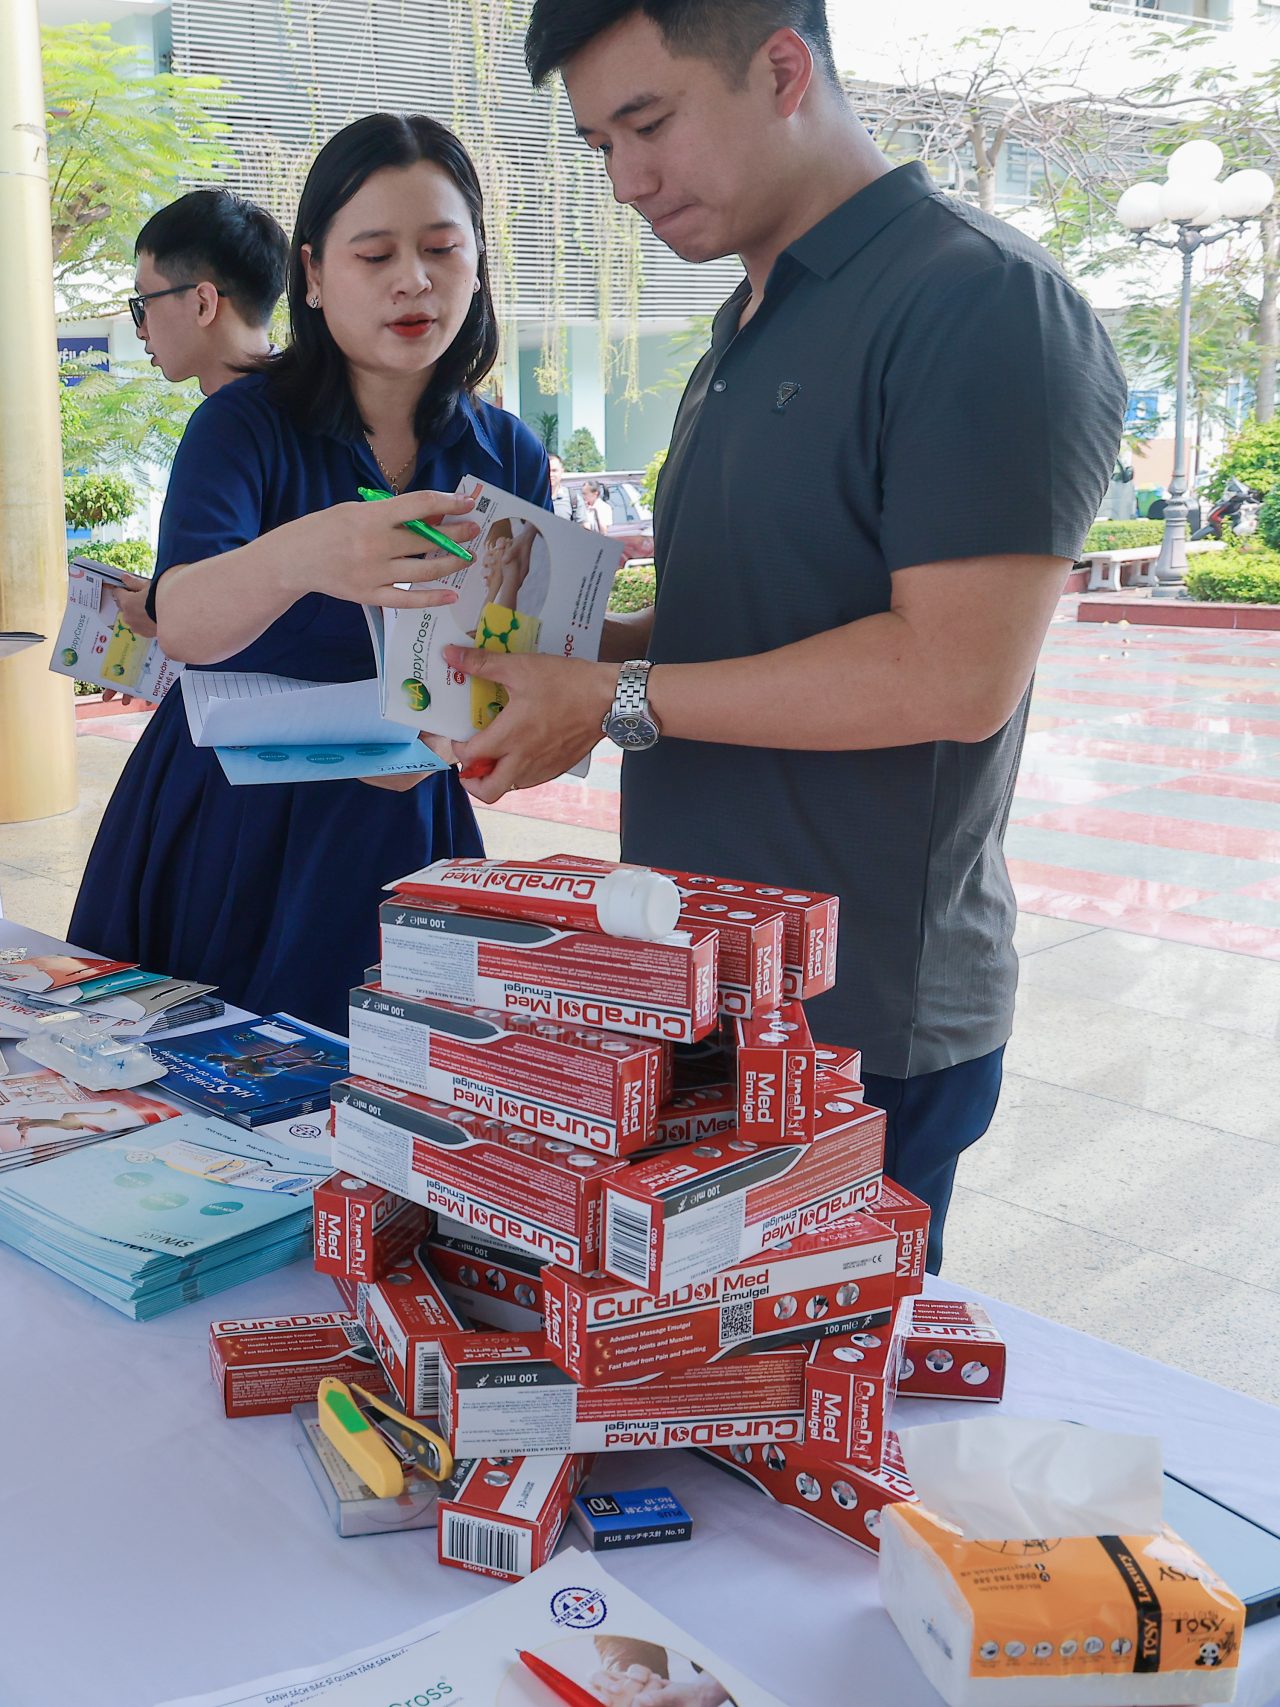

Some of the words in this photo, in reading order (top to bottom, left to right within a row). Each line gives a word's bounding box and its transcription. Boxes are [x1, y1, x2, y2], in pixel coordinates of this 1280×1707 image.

[440, 869, 481, 890] Med
[486, 869, 596, 901] CuraDol
[429, 918, 446, 930] 100
[807, 928, 816, 980] Emulgel
[814, 927, 825, 977] Med
[756, 947, 764, 1000] Emulgel
[763, 945, 772, 996] Med
[503, 982, 553, 999] Emulgel
[695, 967, 703, 1021] Emulgel
[702, 964, 710, 1017] Med
[390, 1005, 405, 1017] 100
[505, 993, 551, 1017] Med
[557, 998, 687, 1040] CuraDol
[452, 1076, 495, 1096] Emulgel
[744, 1070, 756, 1124] Emulgel
[758, 1072, 775, 1124] Med
[368, 1104, 382, 1115] 100
[453, 1087, 493, 1113] Med
[621, 1082, 631, 1137] Emulgel
[629, 1080, 643, 1133] Med
[504, 1100, 611, 1150] CuraDol
[426, 1179, 466, 1203] Emulgel
[706, 1185, 722, 1198] 100
[427, 1190, 465, 1218] Med
[798, 1180, 881, 1235] CuraDol
[585, 1199, 594, 1254] Emulgel
[761, 1209, 798, 1231] Emulgel
[318, 1210, 328, 1259] Emulgel
[328, 1214, 342, 1261] Med
[470, 1204, 576, 1267] CuraDol
[761, 1221, 796, 1248] Med
[474, 1246, 488, 1257] 100
[896, 1230, 914, 1278] Med
[910, 1227, 924, 1278] Emulgel
[593, 1279, 720, 1322] CuraDol
[723, 1268, 770, 1294] Med
[721, 1284, 770, 1303] Emulgel
[218, 1313, 336, 1333] CuraDol
[543, 1289, 552, 1343] Emulgel
[550, 1296, 563, 1350] Med
[824, 1322, 840, 1335] 100
[609, 1332, 639, 1344] Advanced
[639, 1326, 667, 1338] Massage
[667, 1321, 691, 1332] Emulgel
[615, 1345, 638, 1356] Healthy
[638, 1342, 656, 1352] Joints
[656, 1338, 669, 1347] and
[669, 1334, 694, 1345] Muscles
[608, 1363, 622, 1372] Fast
[622, 1358, 640, 1369] Relief
[640, 1355, 655, 1364] from
[655, 1353, 669, 1362] Pain
[669, 1350, 681, 1358] and
[681, 1345, 707, 1356] Swelling
[519, 1373, 539, 1383] 100
[604, 1421, 660, 1433] Emulgel
[809, 1388, 824, 1441] Emulgel
[822, 1392, 843, 1443] Med
[605, 1431, 657, 1448] Med
[663, 1419, 799, 1446] CuraDol
[590, 1497, 613, 1512] 10
[643, 1495, 675, 1506] No.10
[656, 1510, 683, 1519] PLUS
[604, 1533, 622, 1543] PLUS
[624, 1530, 661, 1541] ホッチキス針
[664, 1528, 686, 1536] No.10
[554, 1608, 573, 1625] MADE
[572, 1603, 581, 1614] IN
[578, 1589, 604, 1610] FRANCE
[1171, 1617, 1226, 1635] TOSY
[1142, 1618, 1158, 1659] TOSY
[265, 1692, 289, 1704] DANH
[289, 1684, 310, 1699] SÁCH
[334, 1670, 358, 1684] QUAN
